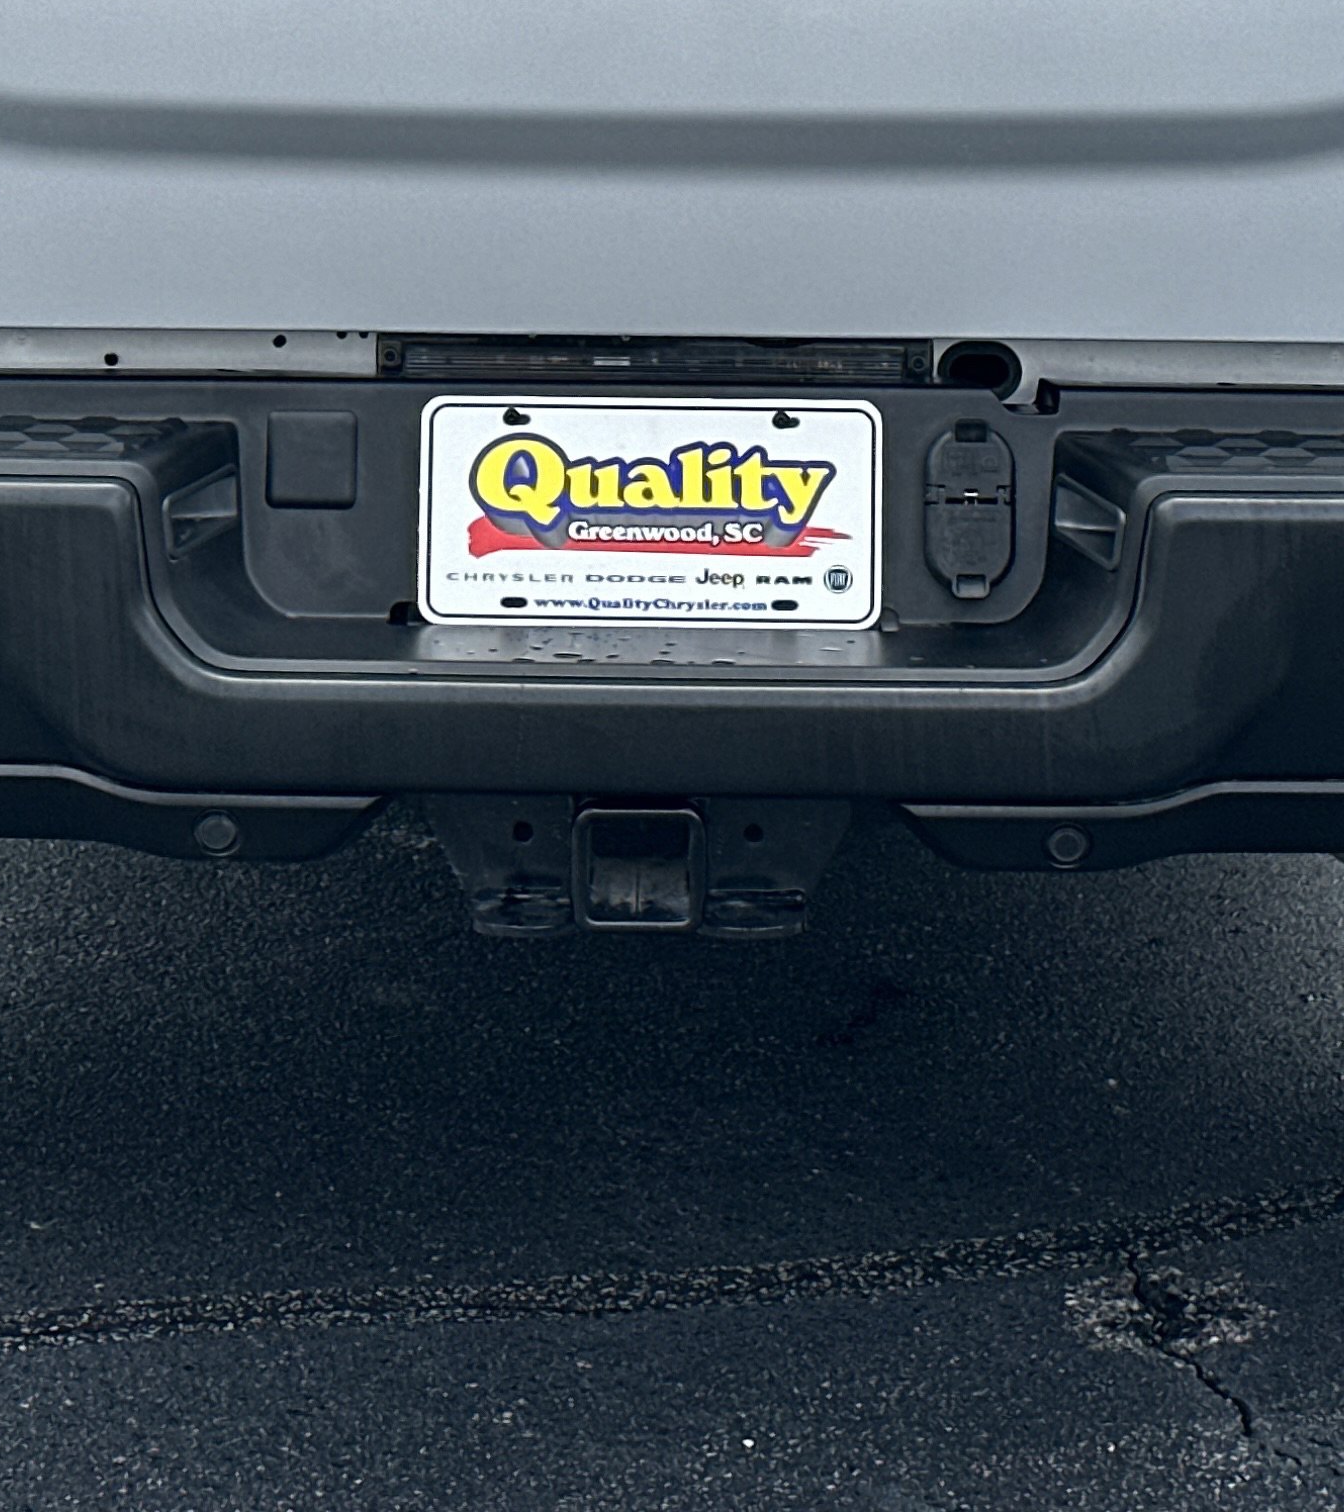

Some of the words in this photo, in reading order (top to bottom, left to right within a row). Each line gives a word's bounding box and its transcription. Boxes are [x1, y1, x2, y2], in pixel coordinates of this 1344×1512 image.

[473, 436, 833, 528] Quality
[567, 520, 720, 546] Greenwood,
[723, 522, 764, 544] SC
[446, 572, 574, 583] CHRYSLER
[585, 574, 686, 583] DODGE
[695, 568, 745, 588] Jeep
[755, 575, 813, 585] RAM
[534, 597, 767, 612] www.QualityChrysler.com
